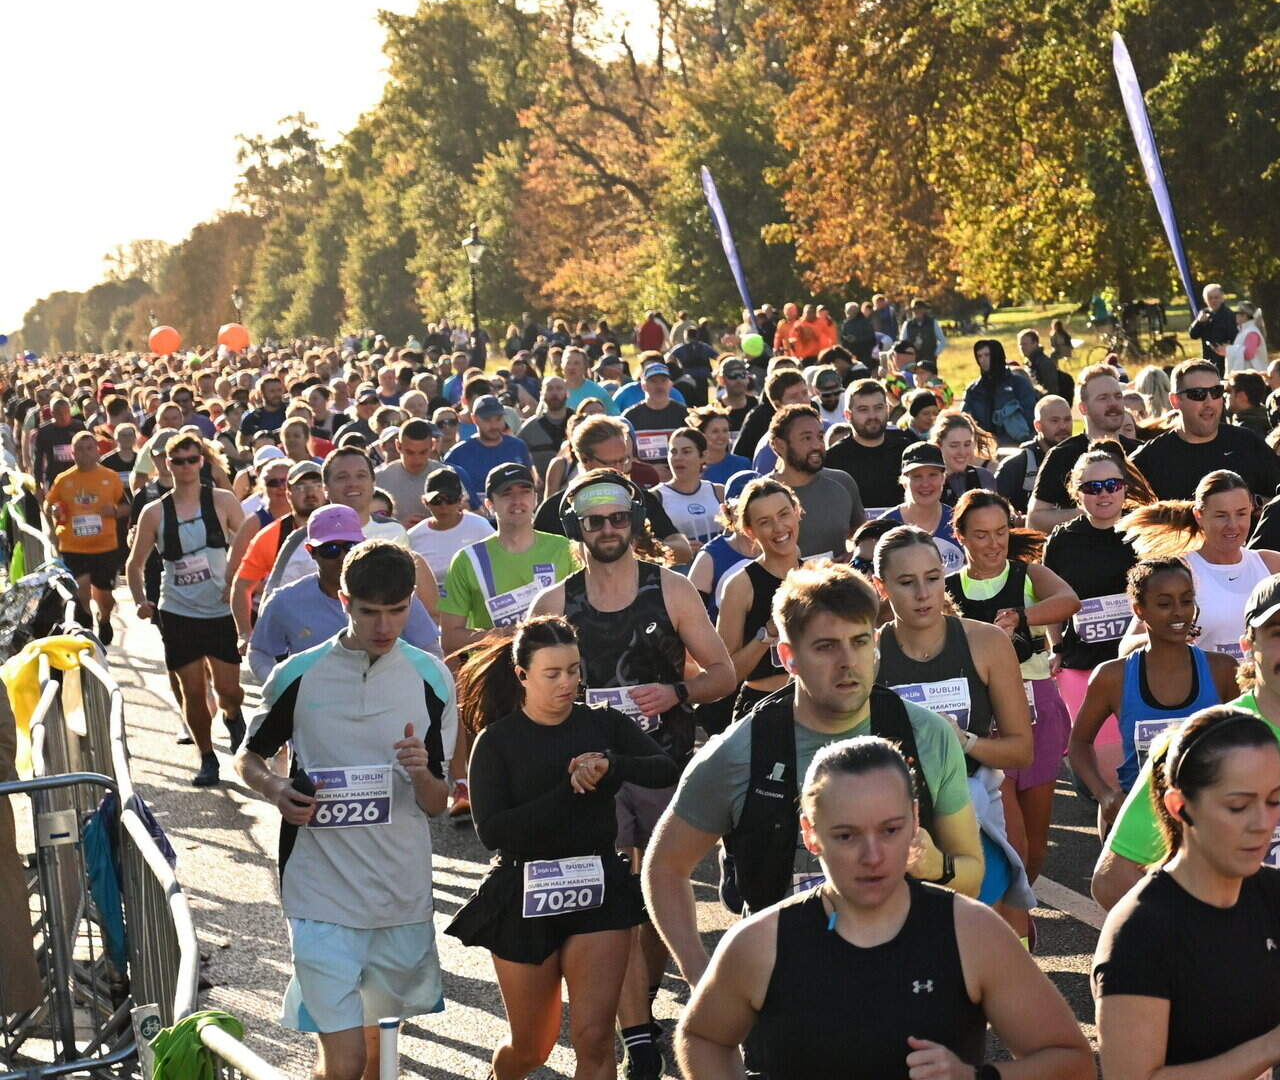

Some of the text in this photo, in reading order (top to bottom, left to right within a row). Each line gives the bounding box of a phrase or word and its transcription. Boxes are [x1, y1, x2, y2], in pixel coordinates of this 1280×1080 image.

[1085, 620, 1126, 639] 5517
[929, 685, 961, 694] DUBLIN
[929, 702, 966, 711] MARATHON
[351, 773, 384, 781] DUBLIN
[350, 790, 388, 798] MARATHON
[316, 801, 379, 824] 6926
[565, 862, 595, 870] DUBLIN
[528, 881, 549, 889] DUBLIN
[567, 876, 600, 885] MARATHON
[533, 888, 593, 912] 7020
